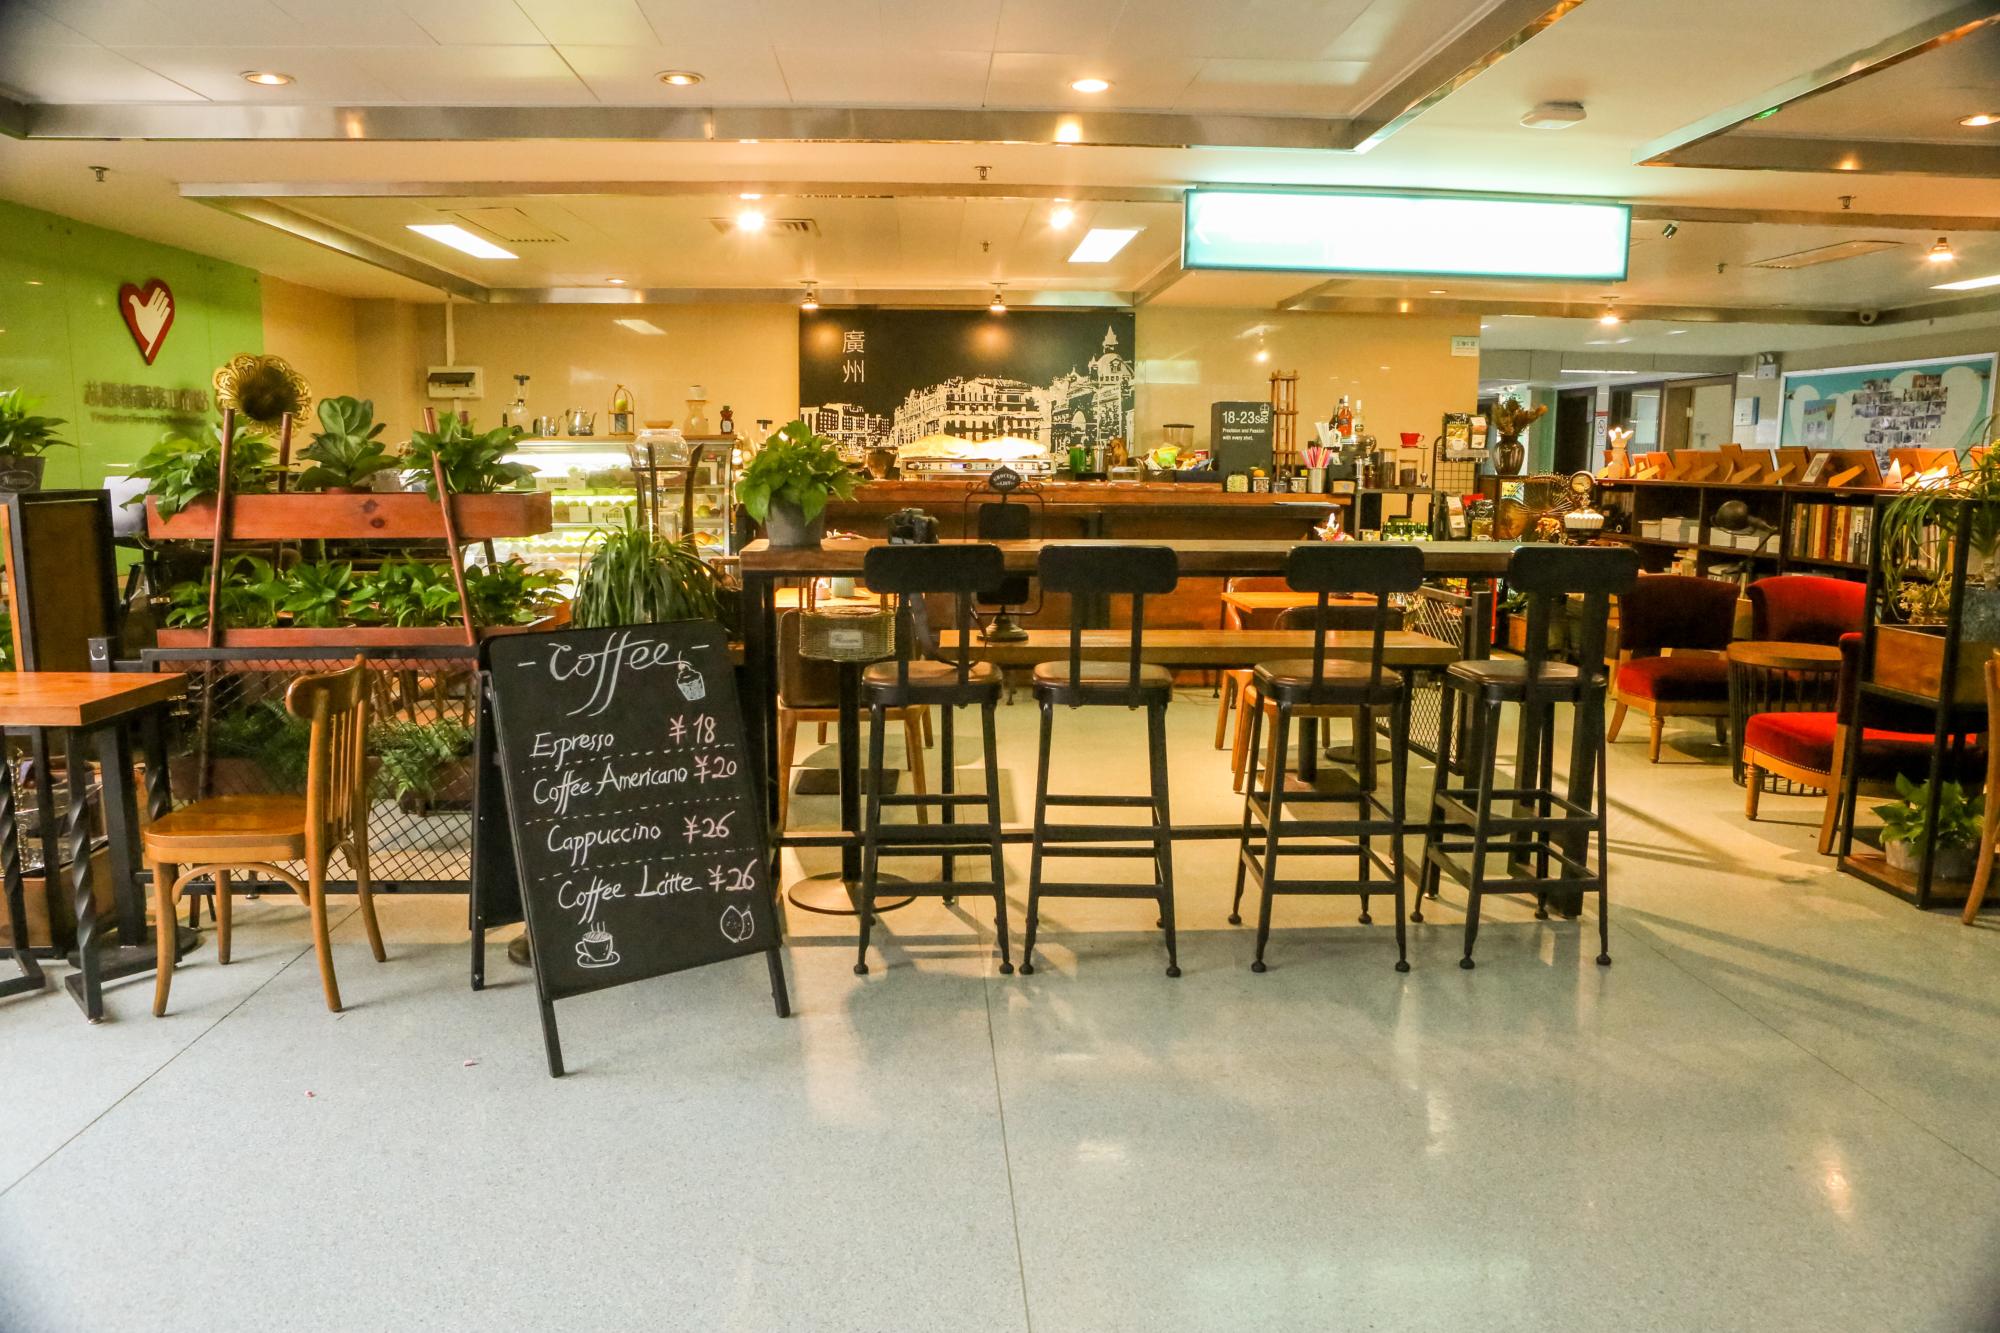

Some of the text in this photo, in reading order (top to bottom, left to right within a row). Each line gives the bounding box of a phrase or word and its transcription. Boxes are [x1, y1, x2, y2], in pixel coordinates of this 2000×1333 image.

[842, 329, 865, 383] 廣州
[548, 631, 692, 717] Coffee
[529, 732, 615, 771] Espresso
[533, 769, 593, 815] Coffee
[595, 763, 688, 796] Americano
[547, 822, 662, 866] Cappuccino
[558, 875, 626, 925] Coffee
